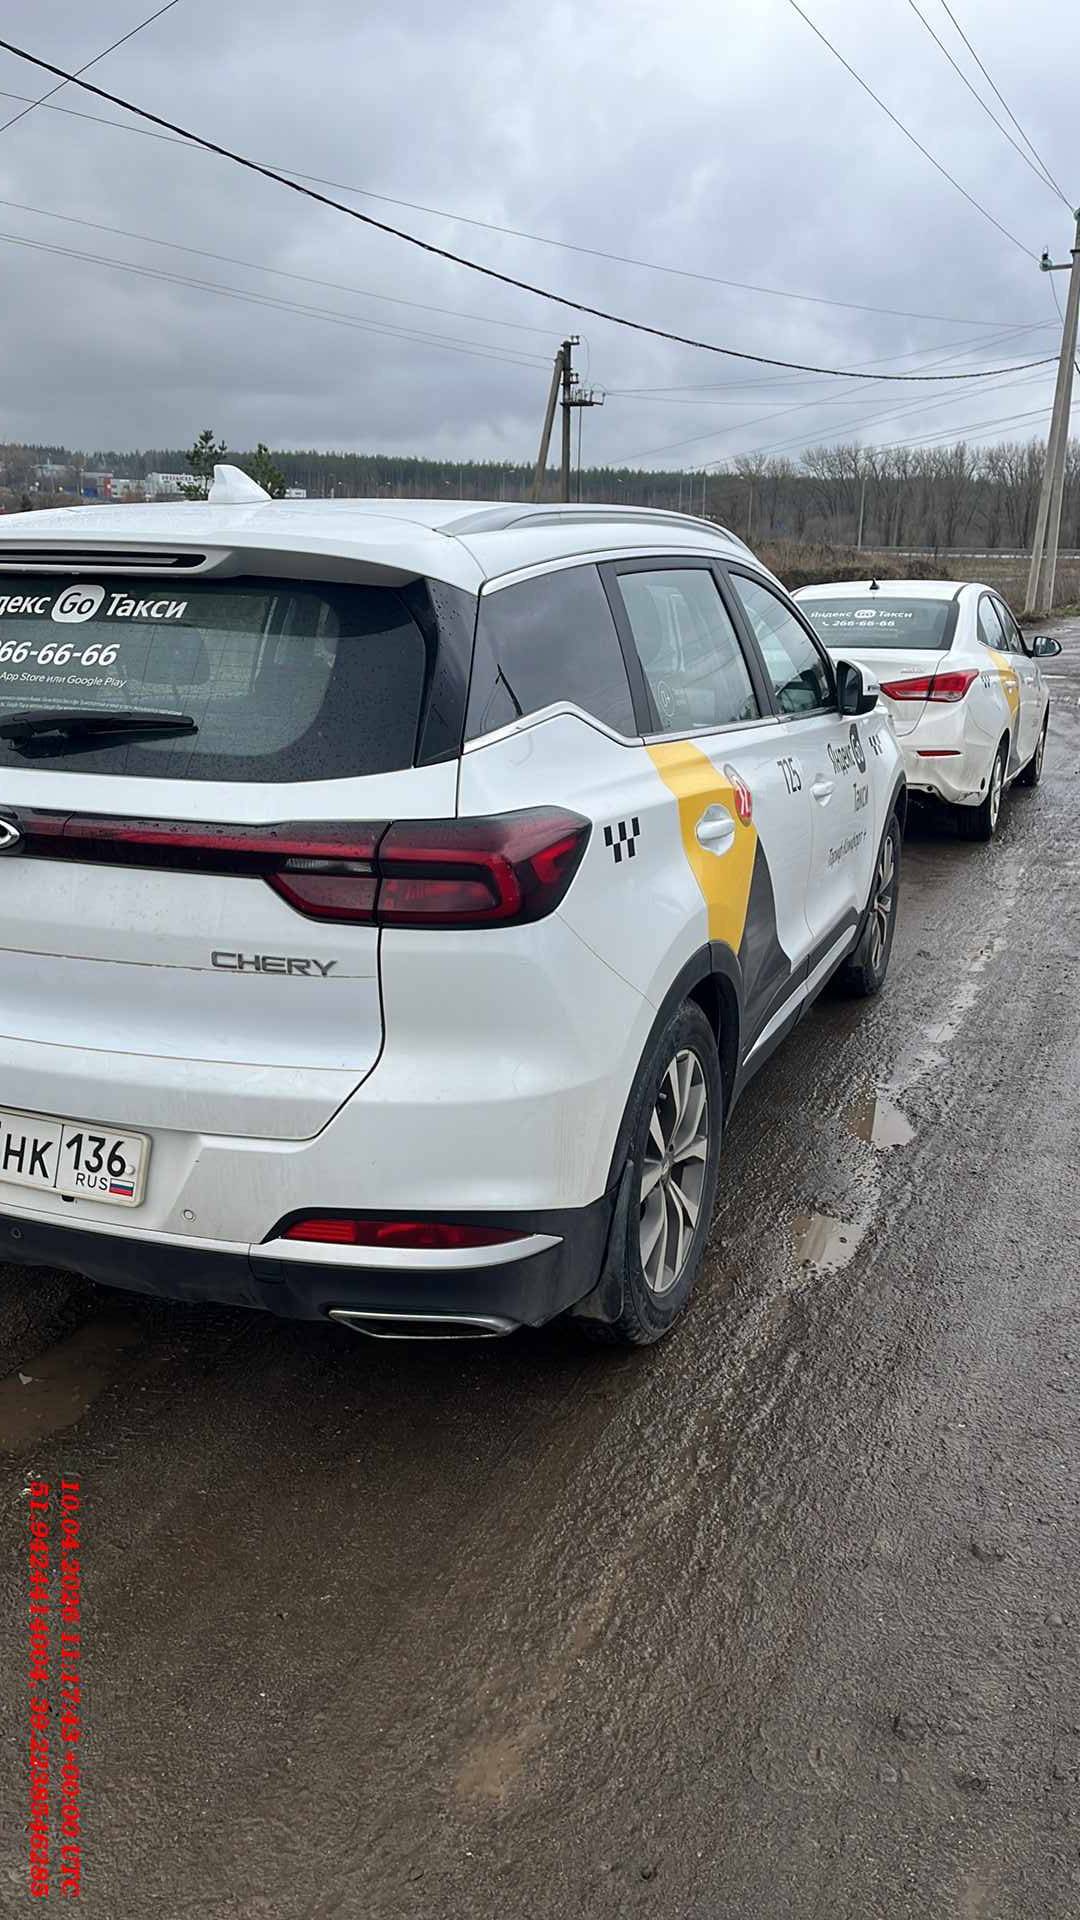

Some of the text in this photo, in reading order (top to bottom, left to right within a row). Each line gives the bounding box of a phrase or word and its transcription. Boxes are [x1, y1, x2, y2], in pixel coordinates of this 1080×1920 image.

[57, 590, 98, 617] Go
[105, 593, 188, 618] Такси
[879, 610, 913, 618] Такси
[20, 672, 46, 683] Store
[67, 674, 102, 687] Google
[104, 676, 127, 688] Play
[211, 951, 337, 977] CHERY
[66, 1133, 126, 1177] 136
[75, 1172, 108, 1191] RUS
